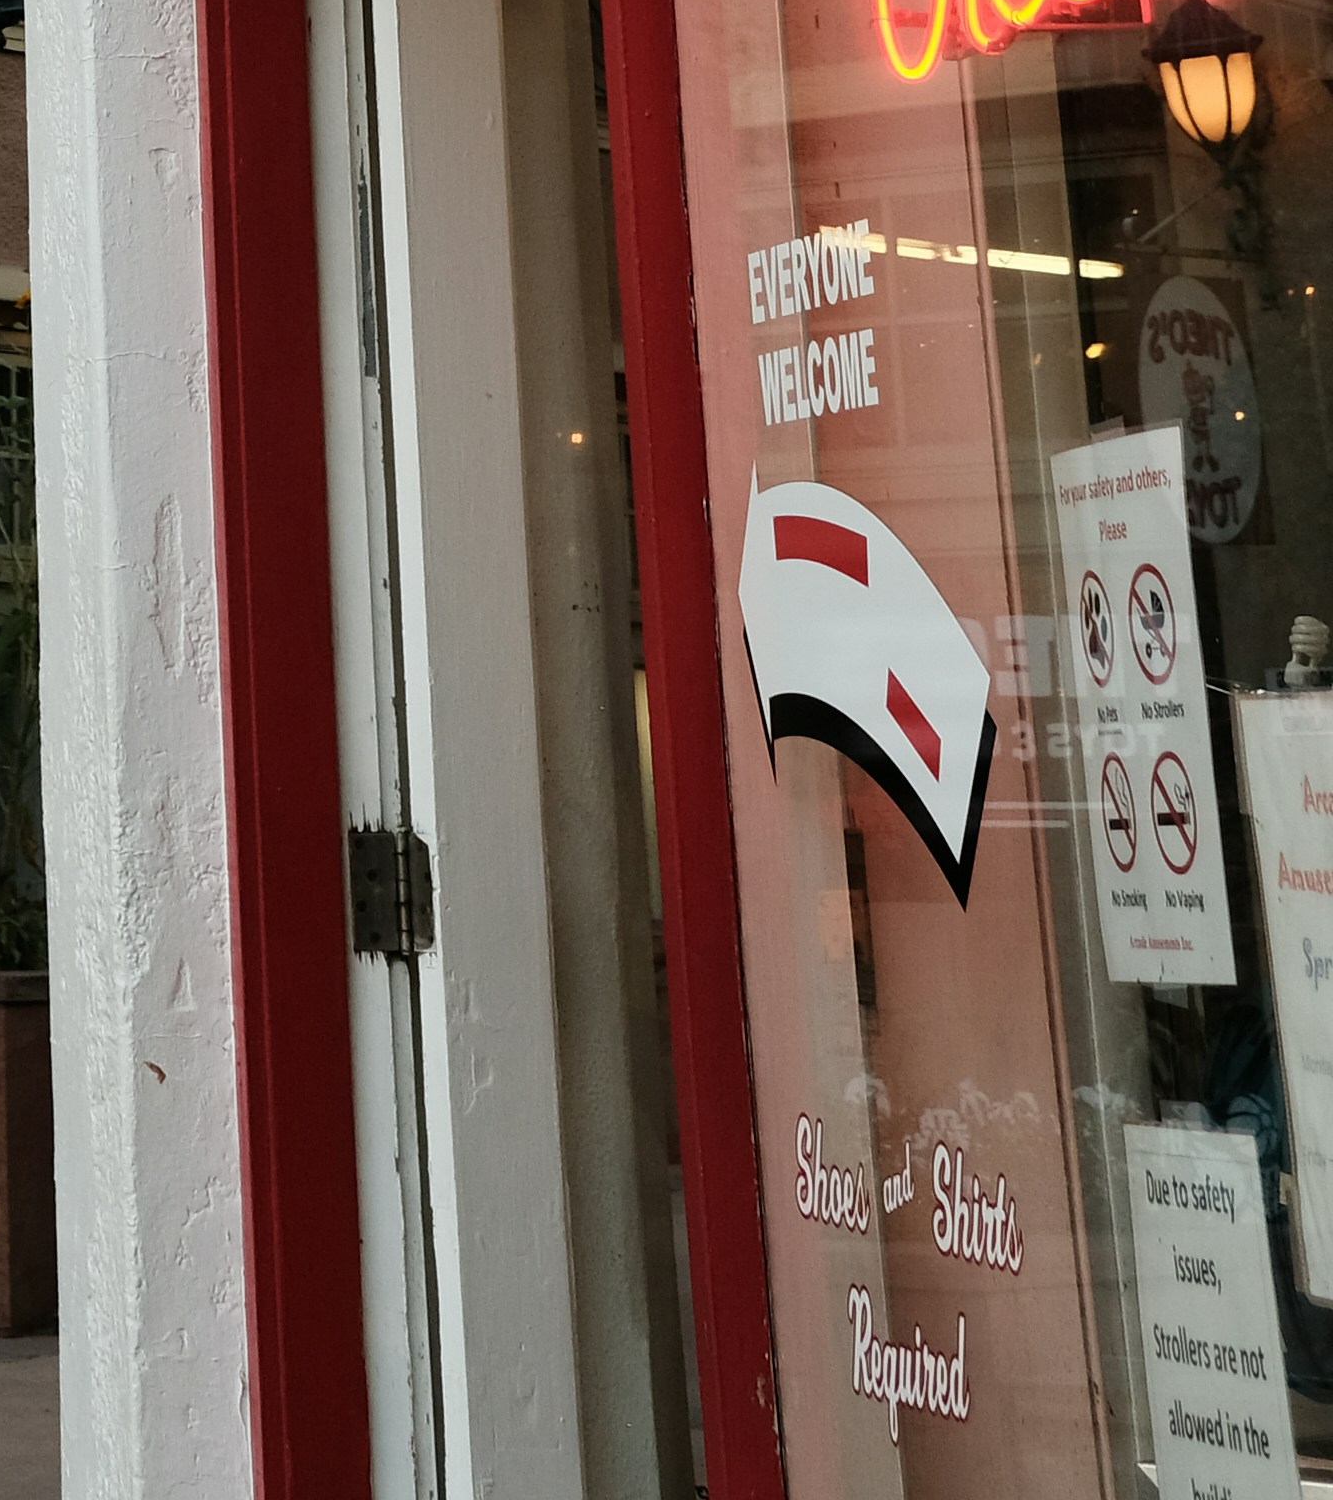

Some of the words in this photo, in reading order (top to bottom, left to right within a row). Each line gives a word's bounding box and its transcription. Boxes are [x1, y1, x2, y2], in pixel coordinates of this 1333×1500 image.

[748, 218, 874, 324] EVERYONE
[758, 328, 879, 426] WELCOME
[1089, 474, 1115, 499] safety
[1116, 469, 1134, 494] and
[1137, 465, 1172, 490] others,
[1098, 519, 1128, 542] Please
[1140, 701, 1153, 720] No
[1153, 699, 1185, 720] Strollers
[1165, 889, 1177, 908] No
[1176, 888, 1205, 913] Vaping
[795, 1112, 871, 1235] Shoes
[883, 1140, 914, 1214] and
[932, 1140, 1025, 1276] Shirts
[1145, 1169, 1170, 1205] Due
[1172, 1175, 1189, 1209] to
[1191, 1174, 1235, 1224] safety
[1172, 1244, 1222, 1295] issues,
[846, 1283, 971, 1446] Required
[1153, 1323, 1211, 1371] Strollers
[1214, 1346, 1238, 1375] are
[1241, 1345, 1268, 1381] not
[1168, 1400, 1225, 1448] allowed
[1226, 1411, 1242, 1453] in
[1244, 1416, 1271, 1460] the
